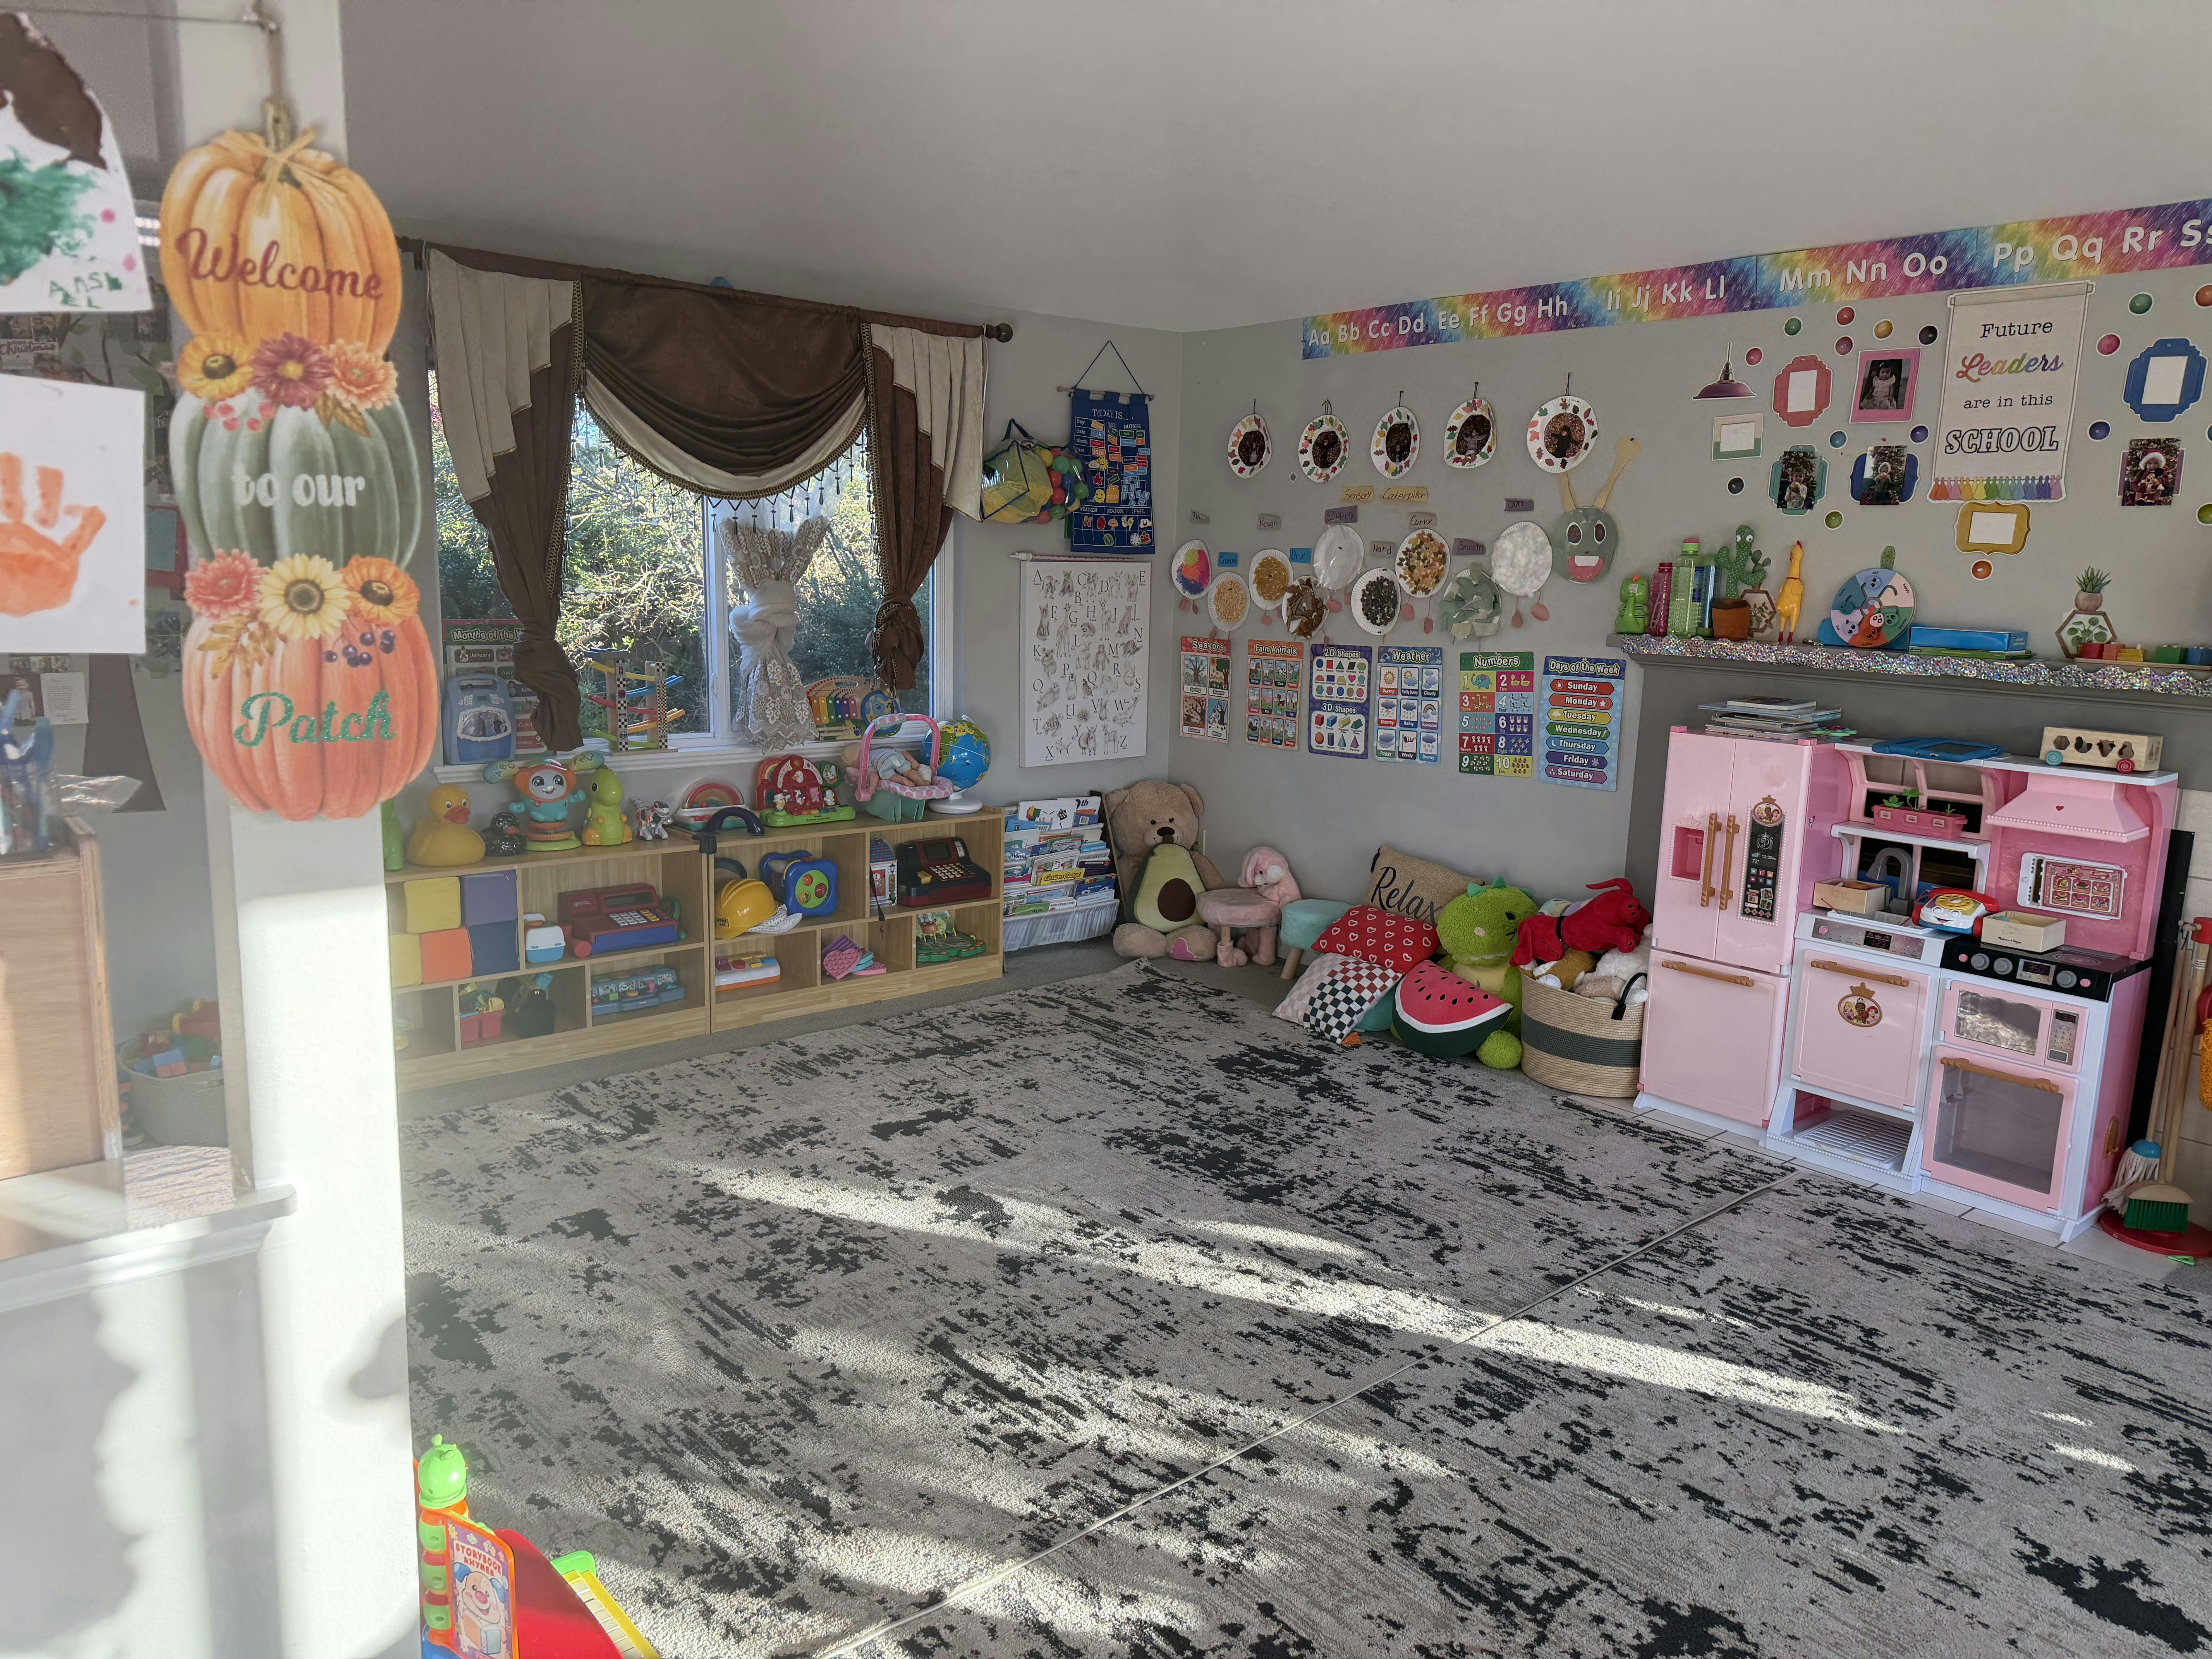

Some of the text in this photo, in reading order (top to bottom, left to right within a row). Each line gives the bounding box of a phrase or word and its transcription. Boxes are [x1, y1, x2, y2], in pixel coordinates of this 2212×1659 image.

[175, 227, 383, 300] Welcome
[1309, 329, 1330, 347] Aa
[1338, 325, 1360, 343] Bb
[1368, 321, 1389, 338] Cc
[1399, 312, 1424, 335] Dd
[1439, 311, 1460, 330] Ee
[1470, 304, 1489, 325] Ff
[1497, 302, 1527, 326] Gg
[1537, 295, 1568, 319] Hh
[1607, 290, 1621, 311] Ii
[1632, 287, 1651, 313] Jj
[1663, 280, 1692, 304] Kk
[1705, 275, 1724, 300] Ll
[1780, 265, 1831, 292] Mm
[1847, 261, 1887, 283] Nn
[1903, 252, 1947, 276] Oo
[1994, 243, 2035, 272] Pp
[2052, 235, 2103, 264] Qq
[2123, 227, 2162, 254] Rr
[1980, 321, 2053, 338] Future
[1956, 353, 2064, 383] Leaders
[1964, 394, 2053, 409] are in this
[1092, 409, 1114, 418] TODAY
[1945, 426, 2059, 454] SCHOOL
[232, 466, 365, 507] to our
[1344, 488, 1426, 501] Sensory Caterpillar
[1260, 517, 1278, 528] Rough
[1410, 515, 1432, 526] Curvy
[1373, 544, 1392, 554] Hard
[1291, 550, 1305, 561] Dry
[1033, 570, 1042, 582] A
[1077, 573, 1086, 586] C
[1140, 570, 1145, 582] E
[1101, 580, 1109, 592] D
[1075, 591, 1081, 603] B
[1051, 606, 1057, 618] F
[1069, 611, 1078, 623] G
[1087, 606, 1095, 618] H
[452, 629, 486, 641] Months
[488, 629, 498, 640] of
[500, 628, 515, 640] the
[1134, 628, 1142, 639] N
[1074, 635, 1081, 647] L
[1192, 640, 1225, 652] Seasons
[1034, 645, 1041, 656] K
[1108, 643, 1118, 655] M
[1255, 643, 1297, 655] Farm Animals
[1324, 647, 1360, 659] 2D Shapes
[1393, 650, 1430, 662] Weather
[1474, 654, 1519, 667] Numbers
[1063, 663, 1069, 675] P
[1113, 663, 1121, 675] R
[1549, 660, 1620, 675] Days of the Week
[1087, 671, 1097, 686] Q
[1135, 677, 1140, 689] S
[1463, 674, 1468, 686] 1
[1500, 674, 1507, 686] 2
[1033, 679, 1043, 692] O
[1567, 682, 1598, 692] Sunday
[1092, 699, 1100, 710] V
[1114, 699, 1126, 711] W
[1462, 695, 1469, 706] 3
[1499, 696, 1506, 707] 4
[1565, 697, 1597, 706] Monday
[1066, 704, 1075, 716] U
[1322, 702, 1356, 715] 3D Shapes
[233, 690, 395, 747] Patch
[1462, 716, 1469, 727] 5
[1499, 716, 1506, 728] 6
[1563, 711, 1596, 721] Tuesday
[1033, 719, 1041, 731] T
[1073, 725, 1081, 737] Y
[1555, 725, 1602, 736] Wednesday
[1120, 735, 1127, 747] Z
[1463, 737, 1468, 747] 7
[1498, 736, 1506, 748] 8
[1559, 740, 1595, 751] Thursday
[1046, 746, 1053, 758] X
[1462, 756, 1469, 767] 9
[1496, 756, 1510, 769] 10
[1564, 755, 1589, 764] Friday
[1558, 768, 1593, 780] Saturday
[1371, 867, 1443, 924] Relax
[455, 1542, 502, 1573] STORYBOOK
[464, 1557, 494, 1576] RHYMES
